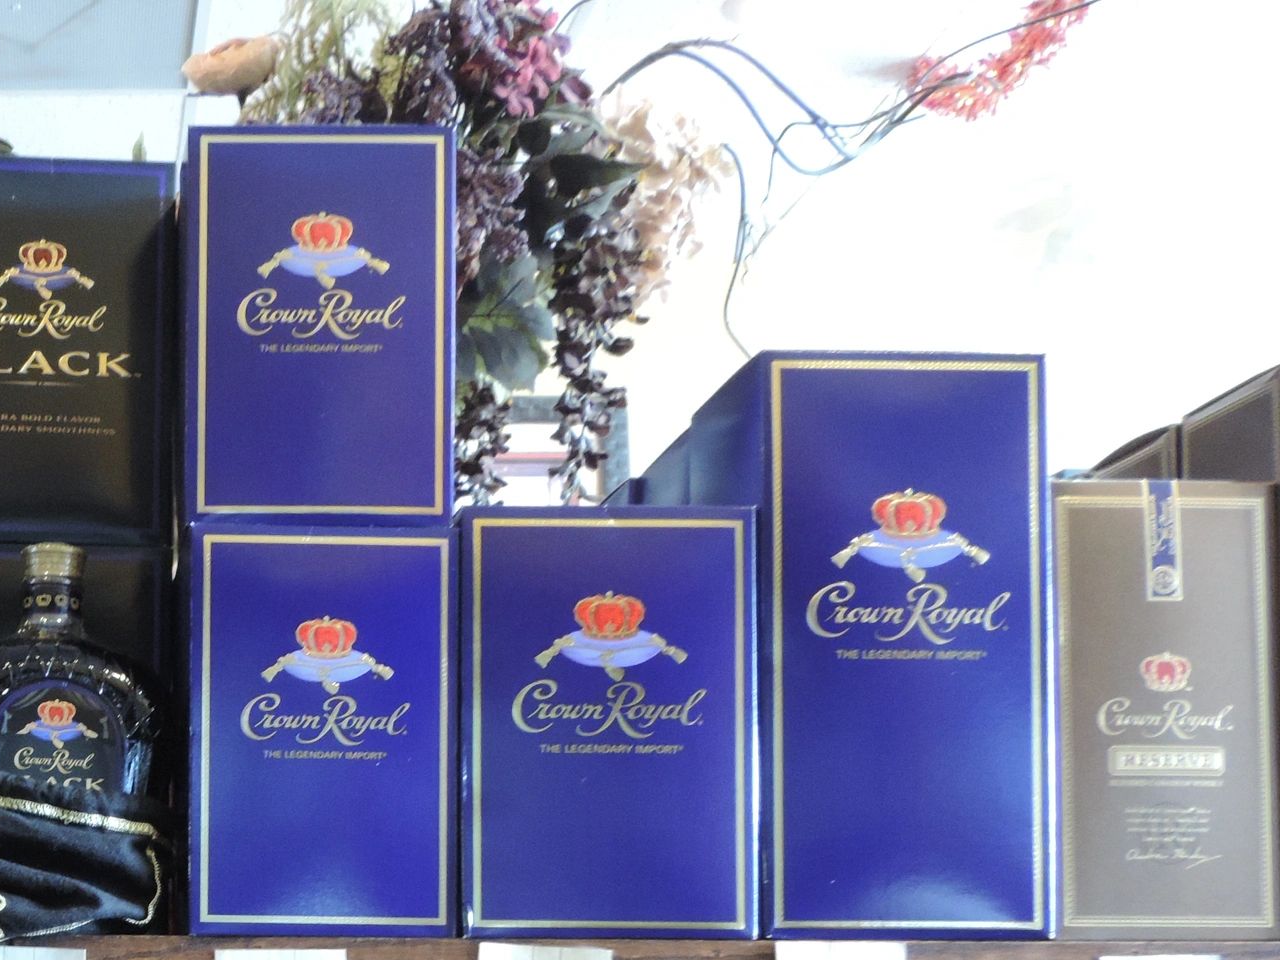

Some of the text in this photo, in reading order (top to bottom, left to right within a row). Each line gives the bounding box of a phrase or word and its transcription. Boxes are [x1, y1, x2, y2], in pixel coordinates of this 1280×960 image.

[17, 299, 107, 340] Royal
[236, 288, 407, 340] Crown Royal
[805, 580, 1012, 645] Crown Royal
[240, 693, 411, 746] Crown Royal
[512, 679, 707, 739] Crown Royal
[1097, 697, 1230, 739] Crown Royal
[13, 747, 96, 775] Crown Royal
